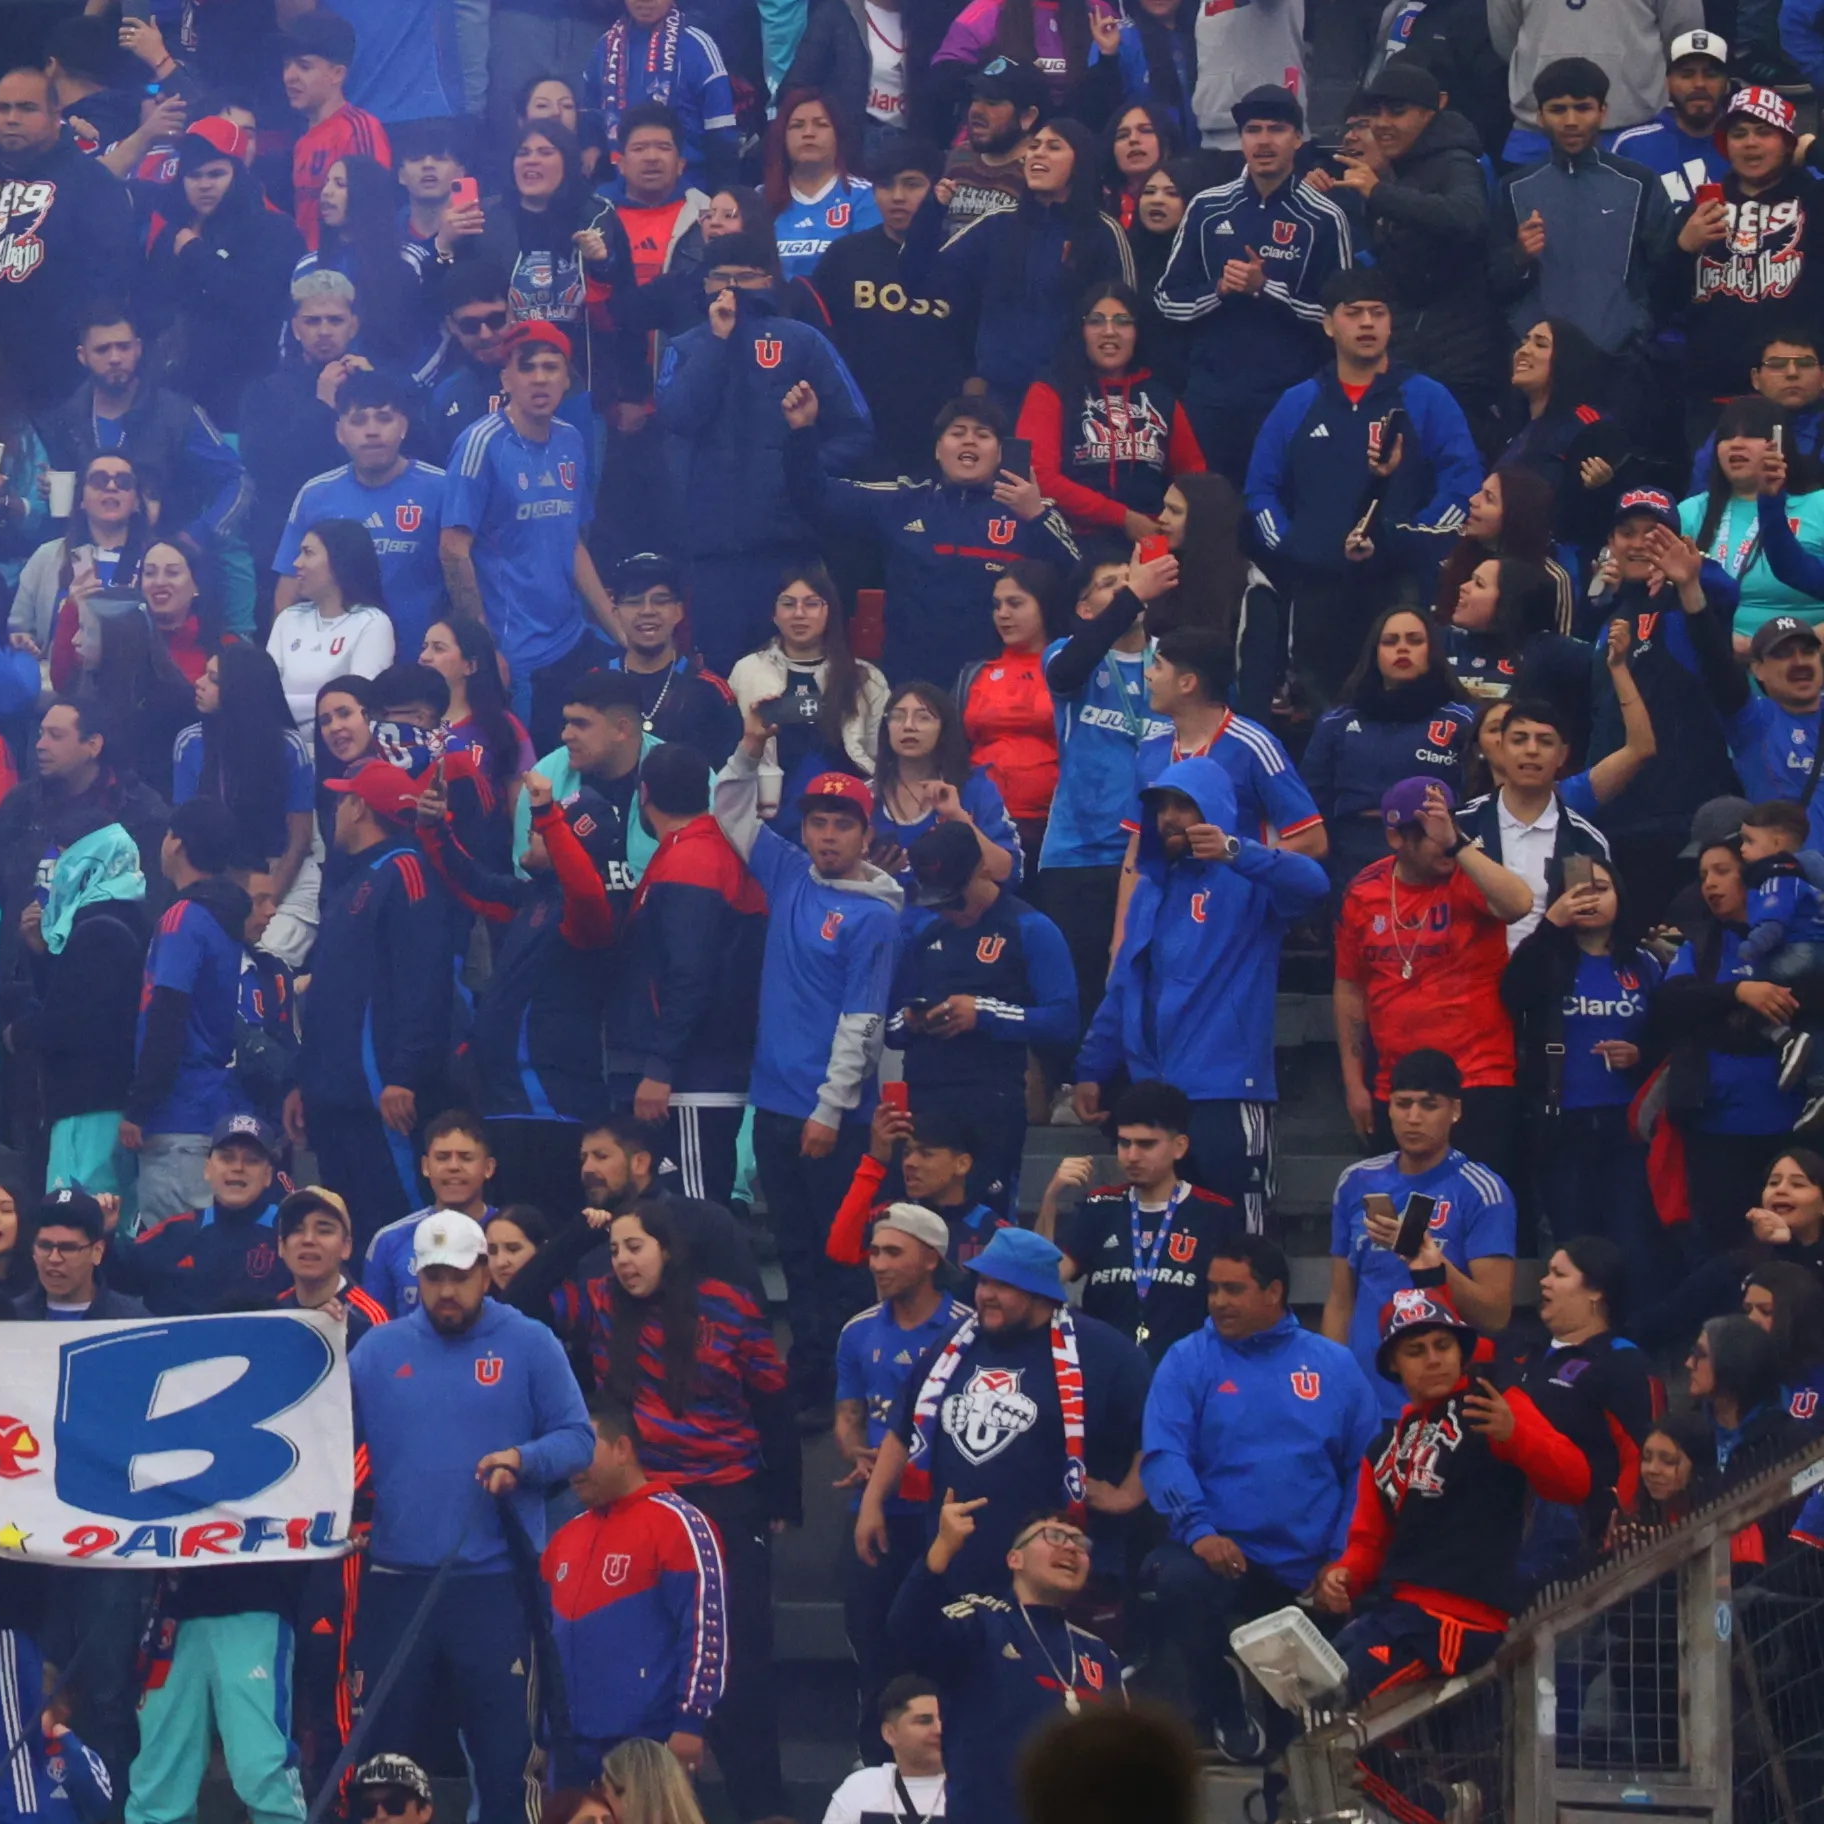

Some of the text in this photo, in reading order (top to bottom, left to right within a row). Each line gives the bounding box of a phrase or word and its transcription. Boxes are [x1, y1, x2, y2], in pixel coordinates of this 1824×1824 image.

[1259, 245, 1294, 260] Claro
[1415, 748, 1453, 766] Claro
[1562, 991, 1633, 1017] Claro
[1090, 1266, 1196, 1286] PETRORAS
[53, 1314, 337, 1520] B
